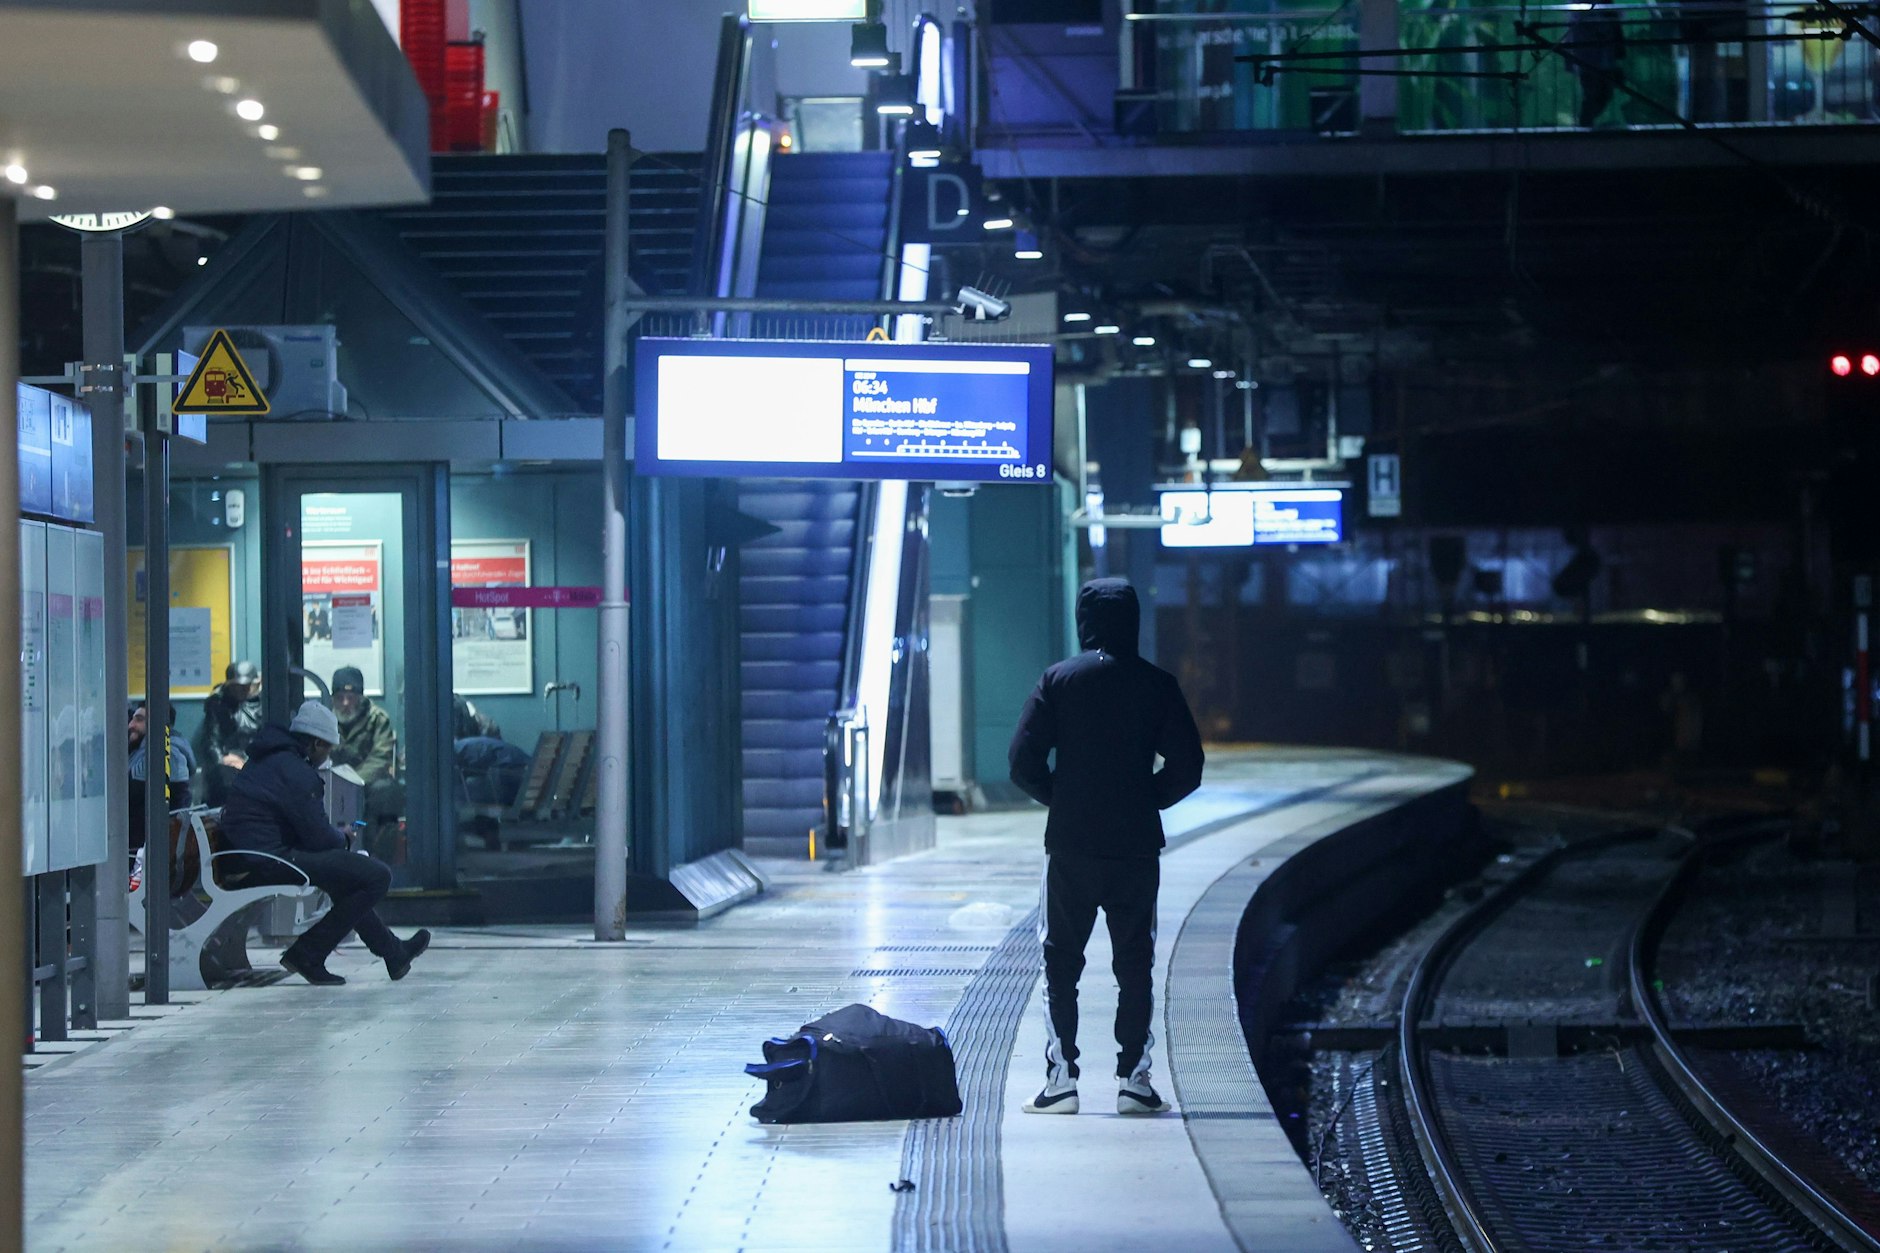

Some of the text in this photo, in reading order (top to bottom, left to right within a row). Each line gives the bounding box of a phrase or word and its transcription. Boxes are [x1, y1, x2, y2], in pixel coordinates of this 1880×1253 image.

[928, 174, 969, 230] D
[853, 380, 888, 394] 06:34
[853, 397, 938, 414] München Hbf
[1000, 464, 1046, 478] Gleis 8
[475, 591, 509, 604] HotSpot
